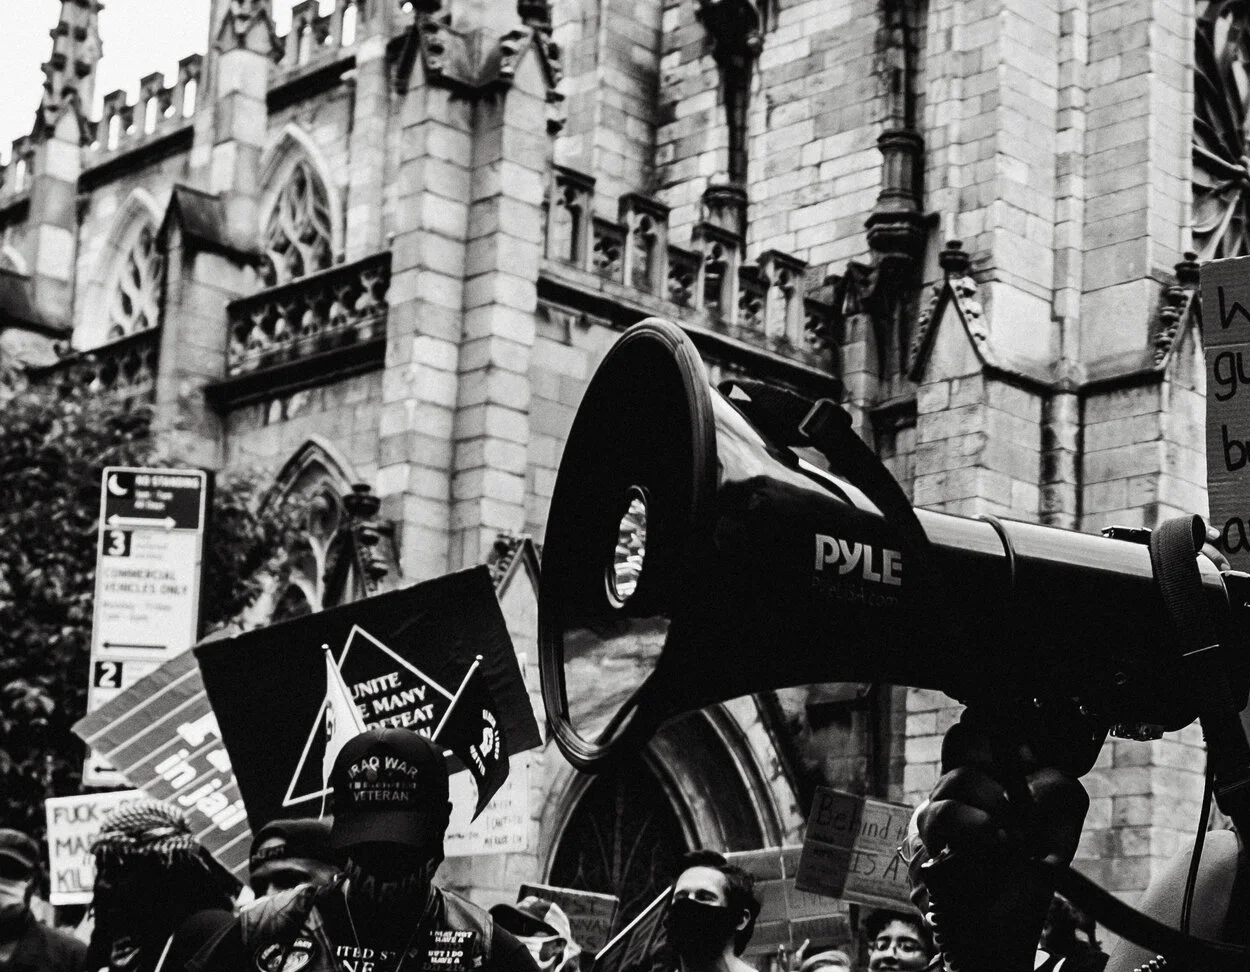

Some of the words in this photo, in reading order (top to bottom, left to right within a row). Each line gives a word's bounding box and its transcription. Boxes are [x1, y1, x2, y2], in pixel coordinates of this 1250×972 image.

[108, 531, 126, 556] 3
[814, 533, 903, 587] PYLE
[99, 661, 117, 688] 2
[372, 684, 427, 715] MANY
[347, 755, 381, 779] IRAQ
[384, 755, 419, 779] WAR
[153, 748, 198, 790] in
[177, 777, 248, 832] jail
[353, 790, 410, 802] VETERAN
[57, 867, 93, 890] KIL
[851, 851, 877, 876] IS
[882, 855, 899, 881] A
